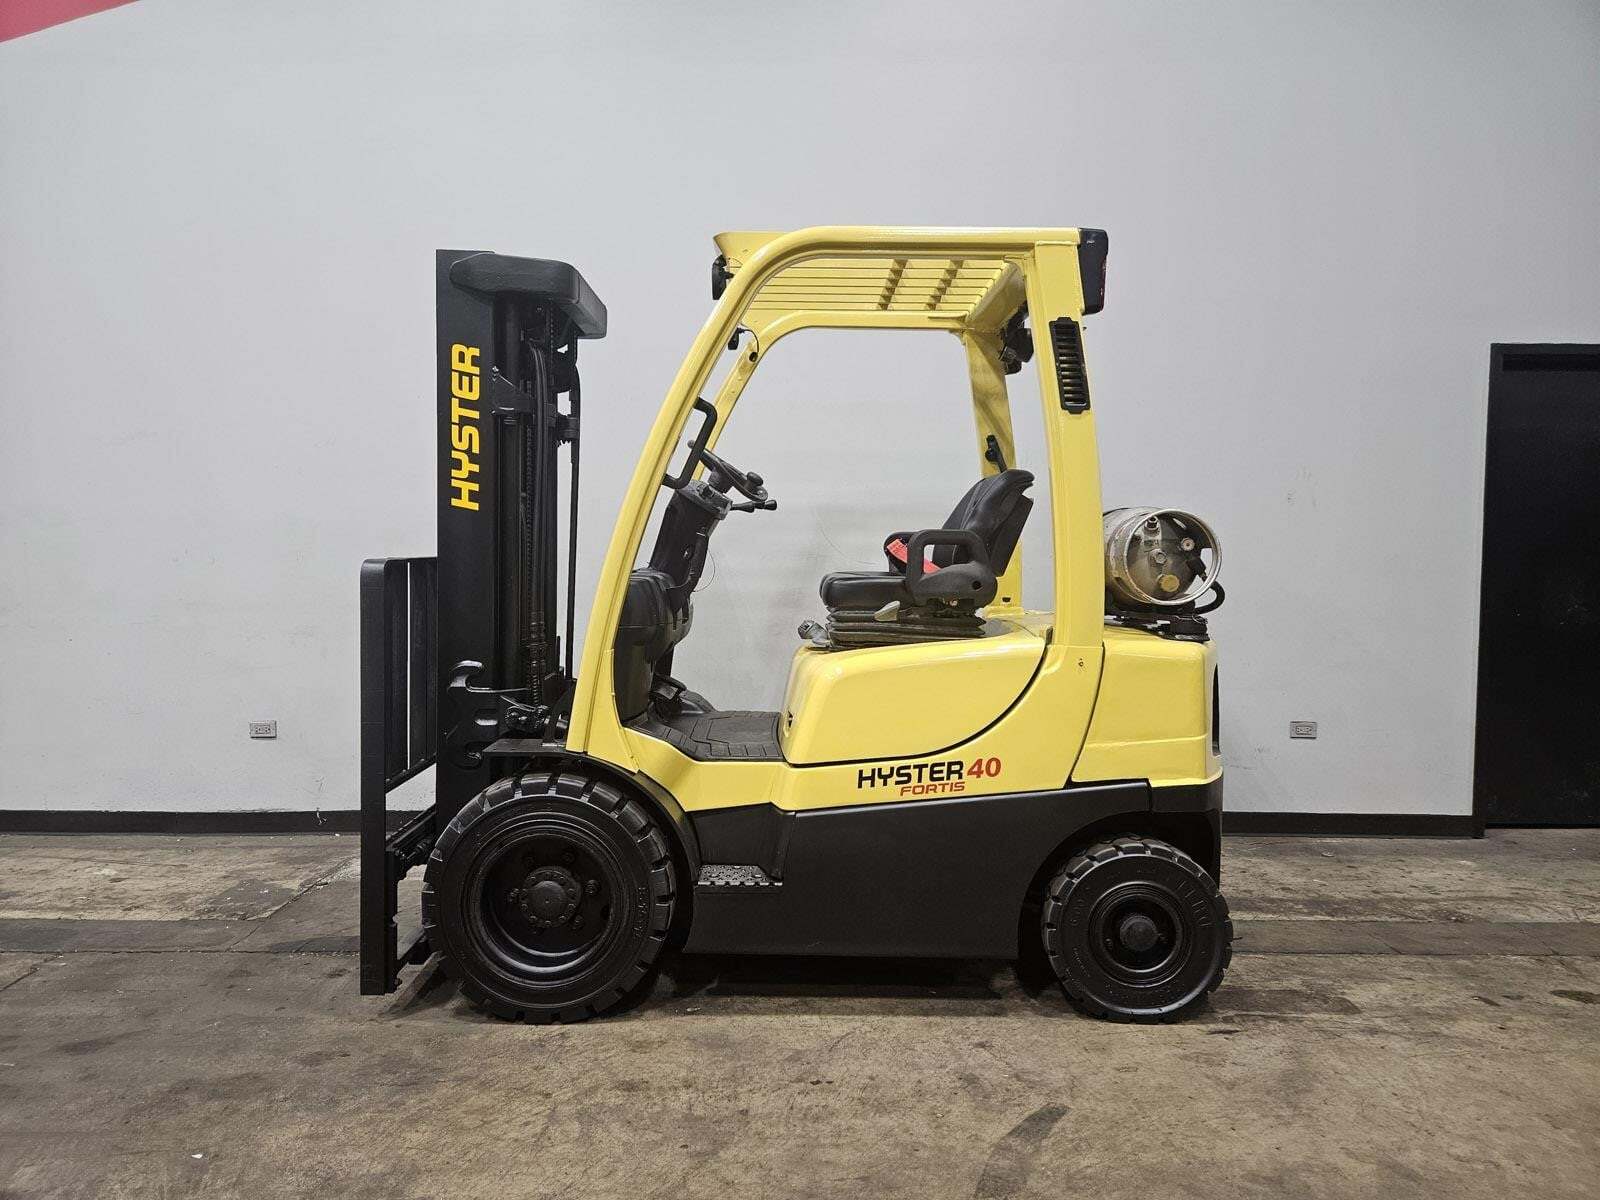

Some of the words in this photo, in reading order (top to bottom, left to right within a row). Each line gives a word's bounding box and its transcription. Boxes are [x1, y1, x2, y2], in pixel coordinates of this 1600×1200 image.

[451, 343, 481, 511] HYSTER
[857, 760, 964, 789] HYSTER
[967, 757, 1001, 779] 40
[900, 781, 965, 797] FORTIS
